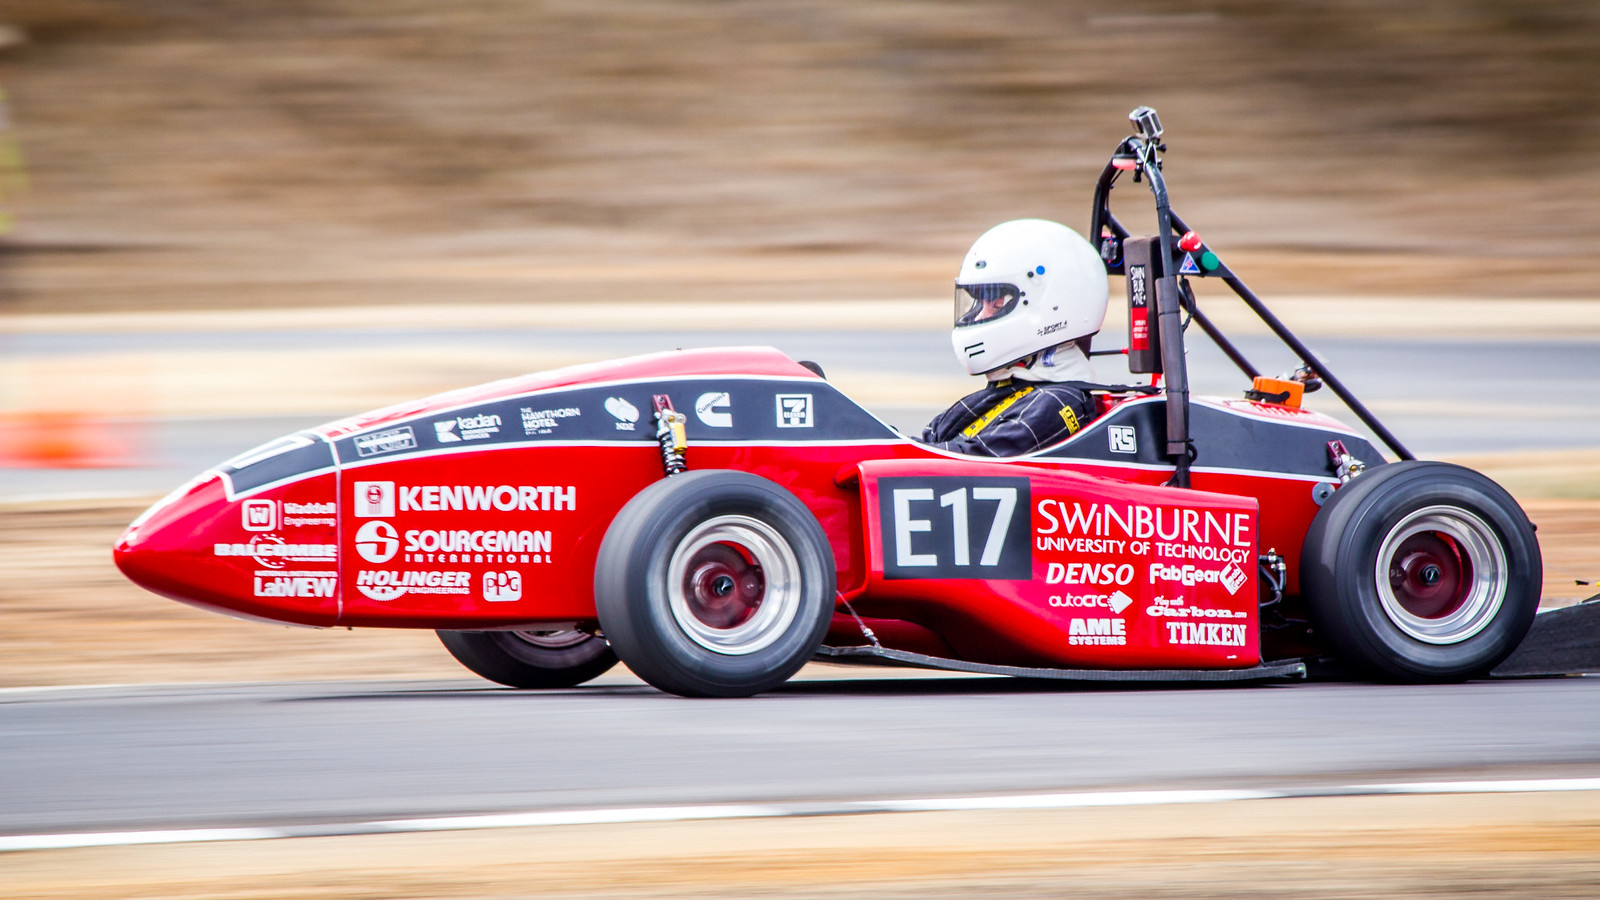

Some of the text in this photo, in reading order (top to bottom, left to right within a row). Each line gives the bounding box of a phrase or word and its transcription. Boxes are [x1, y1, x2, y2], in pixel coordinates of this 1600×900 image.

[697, 393, 726, 414] Cummins
[456, 413, 502, 430] kadan
[521, 407, 581, 421] HAWTHORN
[523, 418, 559, 429] HOTEL
[1111, 427, 1136, 451] RS
[399, 484, 576, 512] KENWORTH
[283, 502, 337, 515] Waddell
[283, 516, 337, 528] Engineering
[893, 487, 1018, 567] E17
[213, 543, 338, 557] BALCOMBE
[404, 530, 552, 553] SOURCEMAN
[1036, 537, 1251, 564] UNIVERSITY OF TECHNOLOGY
[404, 553, 552, 563] INTERNATIONAL
[356, 570, 472, 587] HOLINGER
[1045, 562, 1135, 586] DENSO
[1149, 562, 1220, 587] FabGear
[253, 577, 338, 598] LabVIEW
[407, 586, 471, 595] ENGINEERING
[484, 571, 521, 599] PPG
[1068, 618, 1127, 636] AME
[1166, 621, 1247, 647] TIMKEN
[1068, 635, 1127, 646] SYSTEMS
